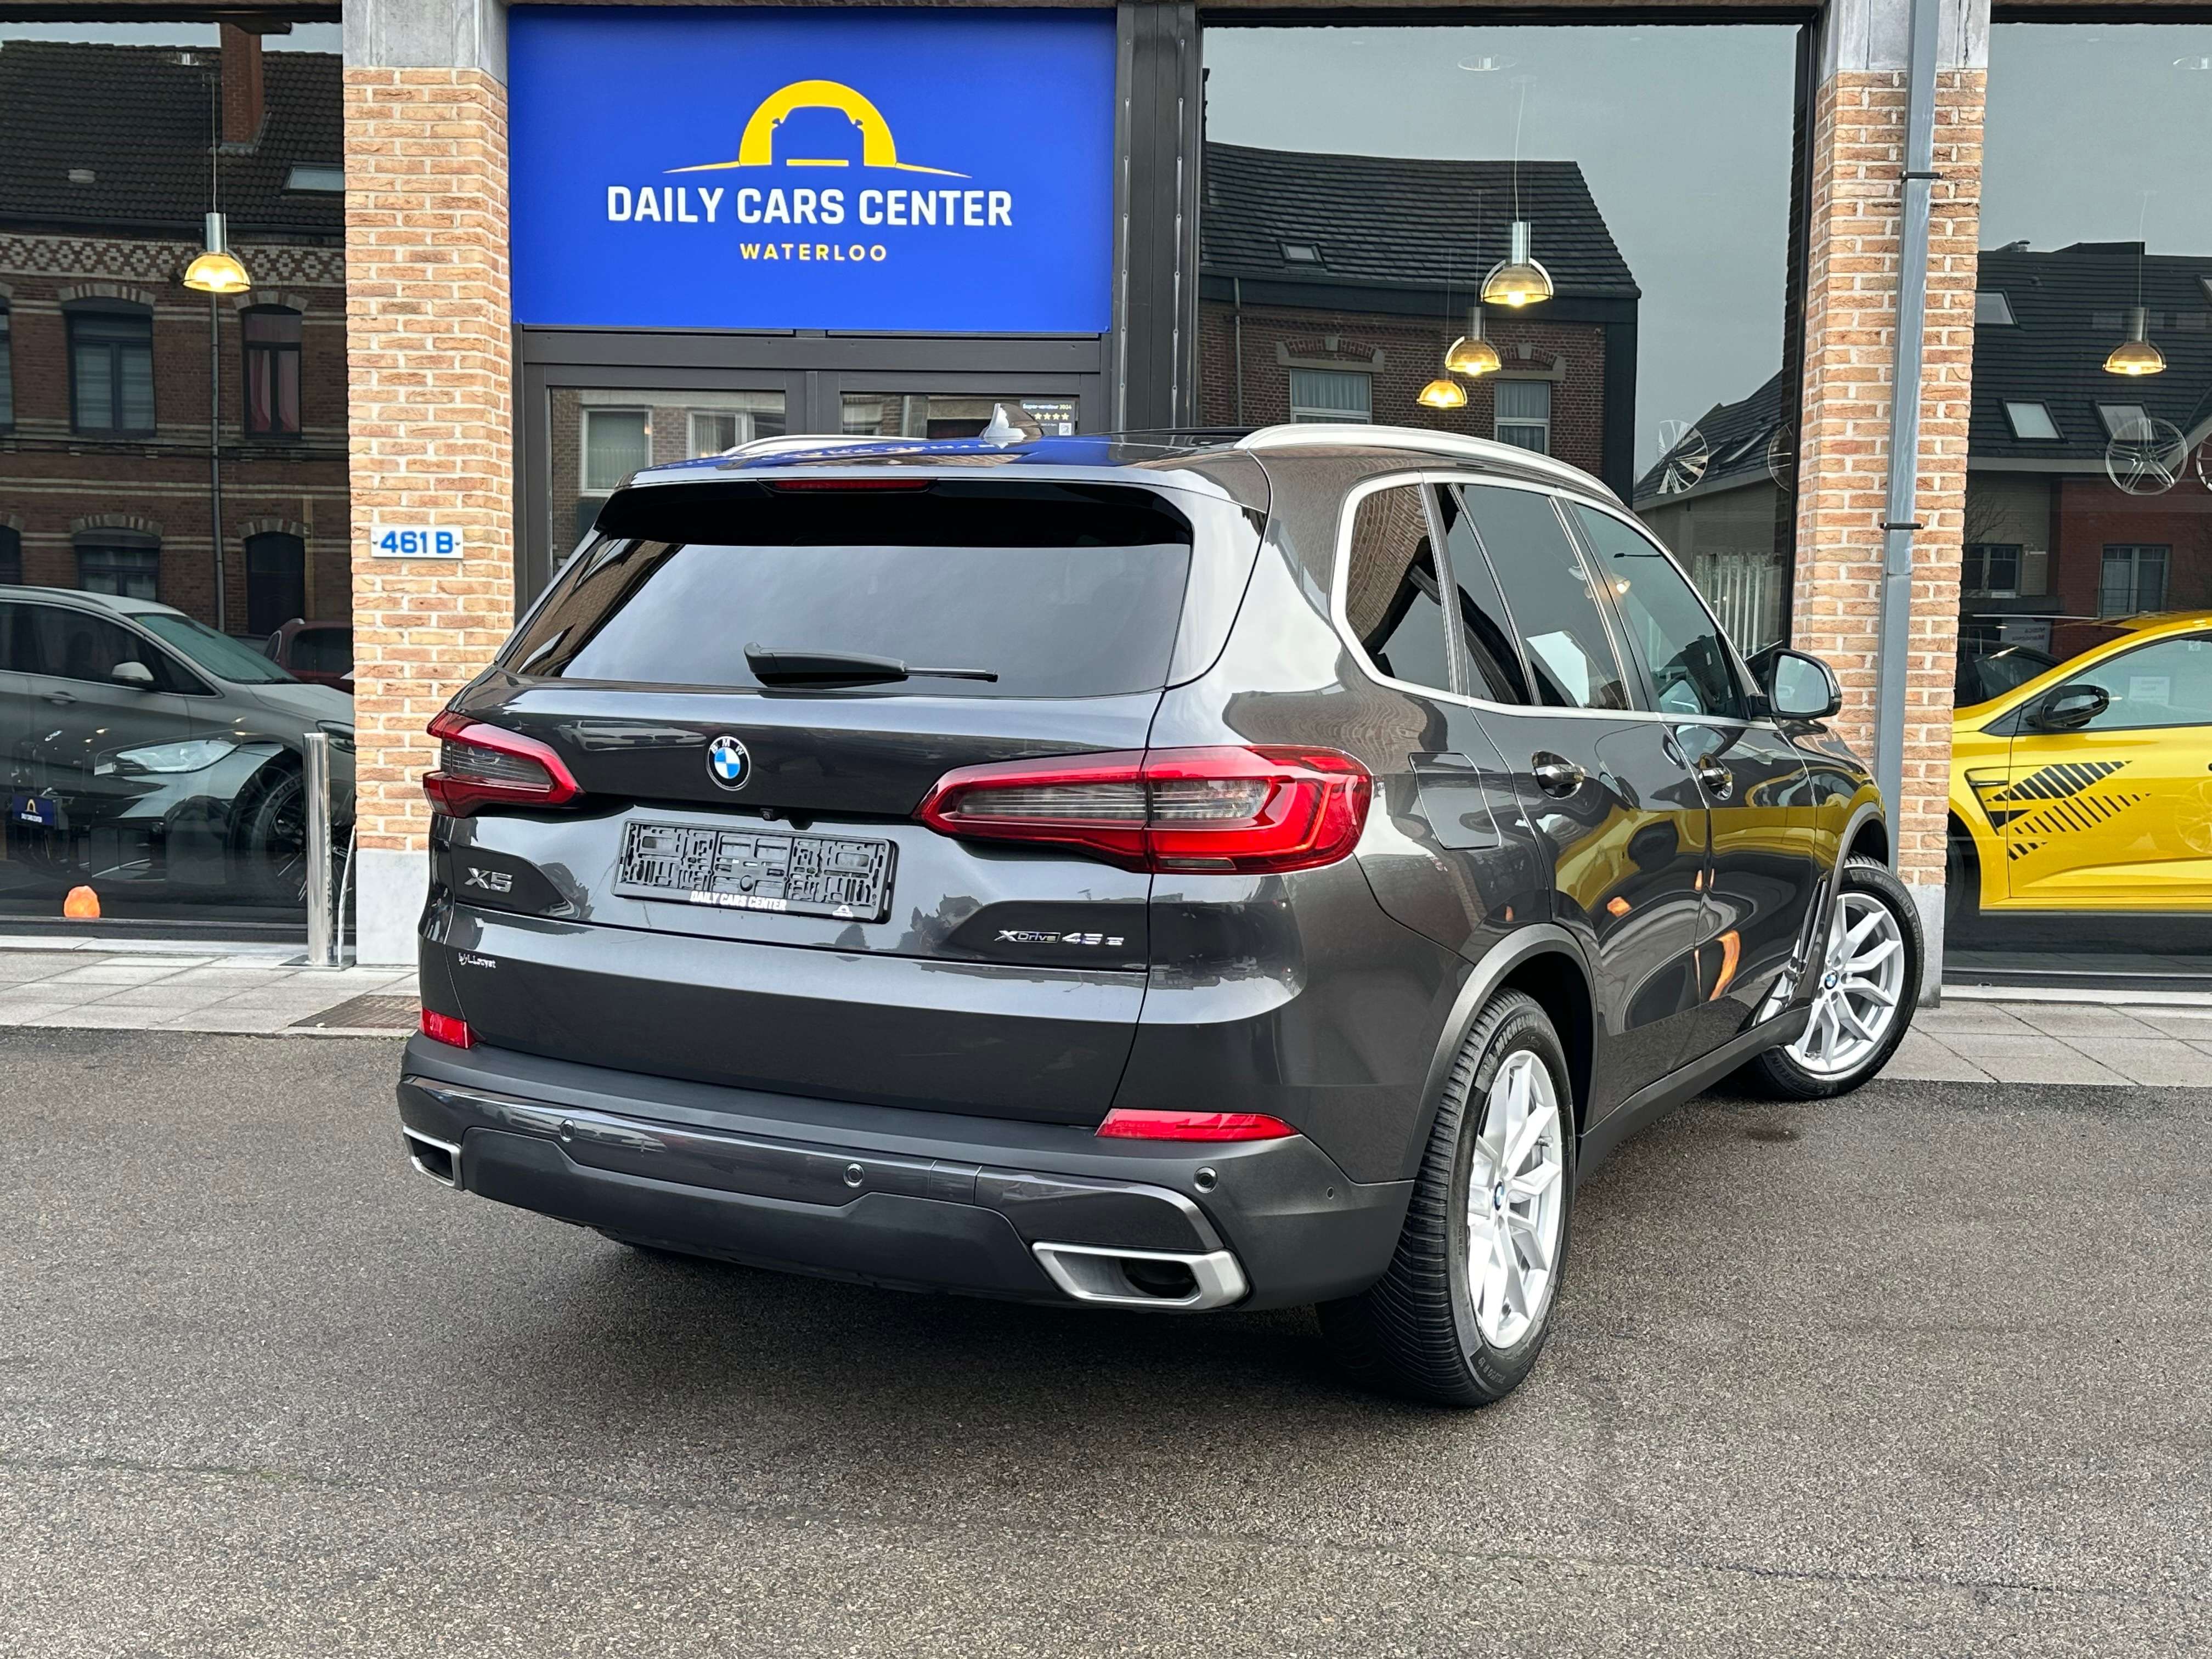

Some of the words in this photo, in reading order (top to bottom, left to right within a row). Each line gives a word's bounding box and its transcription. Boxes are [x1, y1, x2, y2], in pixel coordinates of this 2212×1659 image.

[607, 186, 724, 223] DAILY
[737, 188, 845, 224] CARS
[859, 189, 1013, 227] CENTER
[740, 242, 888, 262] WATERLOO
[380, 531, 427, 554] 461
[436, 531, 453, 554] B
[709, 737, 745, 756] BMW
[464, 867, 514, 893] X5
[690, 890, 720, 904] DAILY
[719, 893, 748, 907] CARS
[748, 896, 787, 911] CENTER
[1495, 1013, 1537, 1057] MICHELIN
